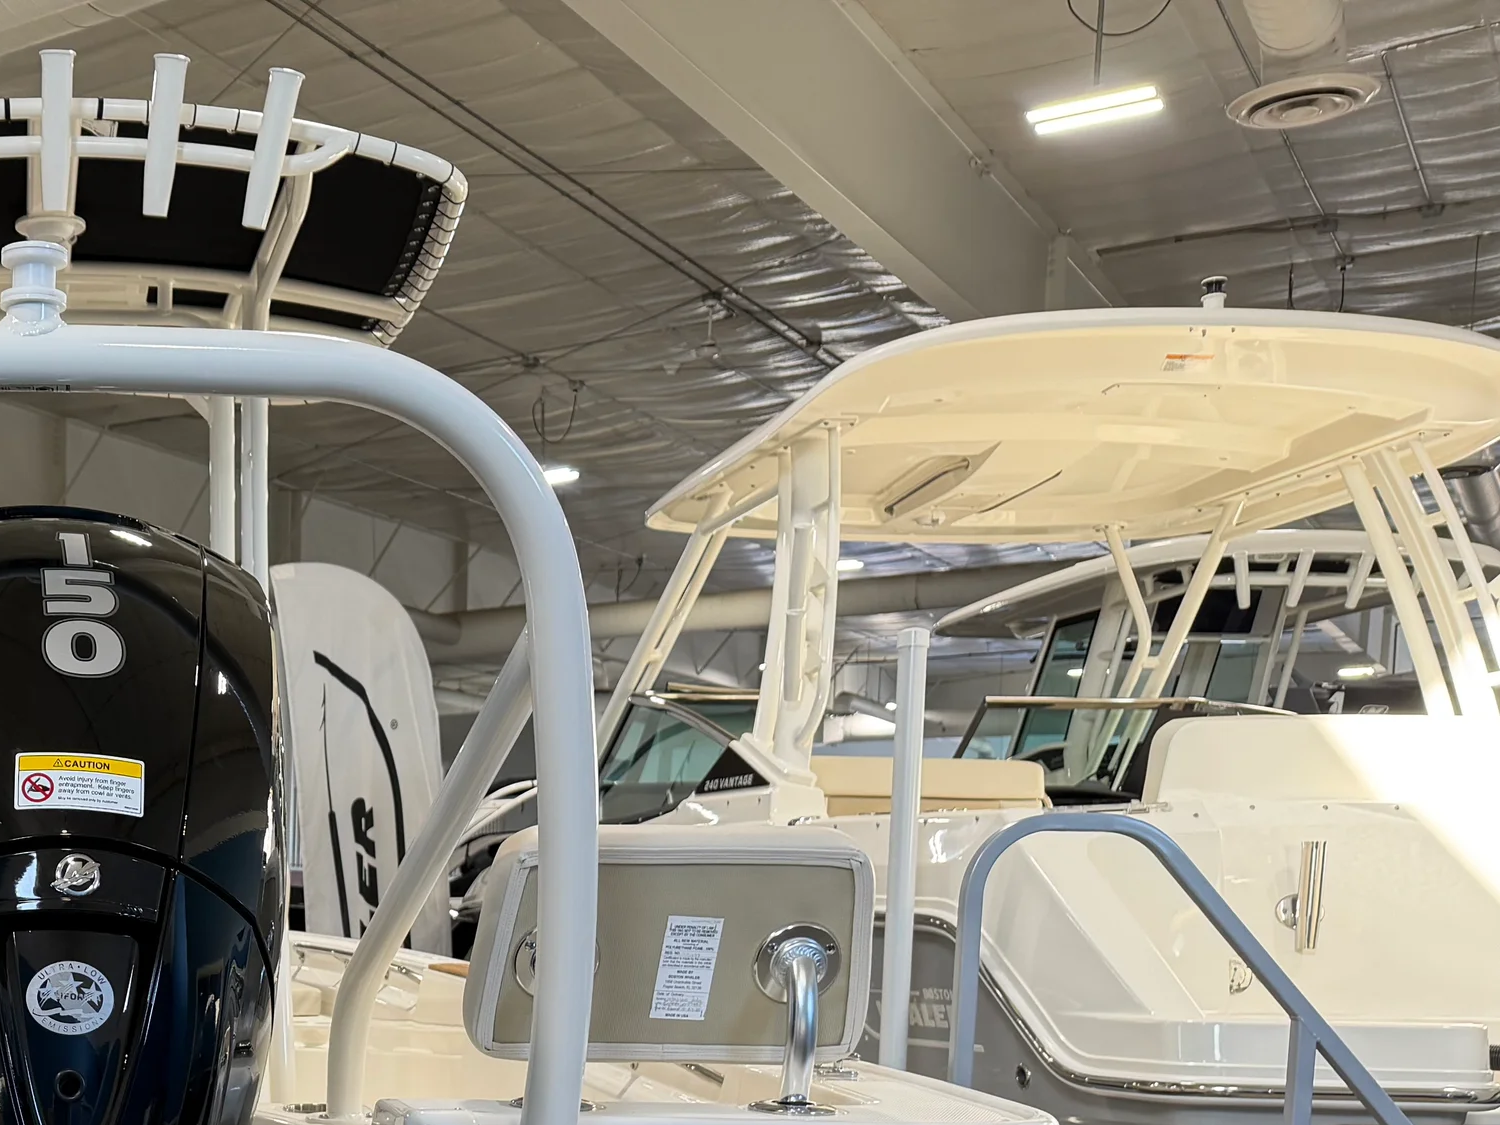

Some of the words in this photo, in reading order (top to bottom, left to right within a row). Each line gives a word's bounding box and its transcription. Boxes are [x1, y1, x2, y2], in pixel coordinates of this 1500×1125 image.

[40, 531, 126, 678] 150
[64, 760, 110, 770] CAUTION
[110, 778, 126, 787] finger
[704, 778, 719, 791] 240
[720, 773, 754, 789] VANTAGE
[115, 786, 135, 794] fingers
[38, 962, 74, 980] ULTRA
[84, 966, 107, 985] LOW
[922, 987, 952, 1001] BOSTO
[41, 1016, 99, 1033] EMISSION
